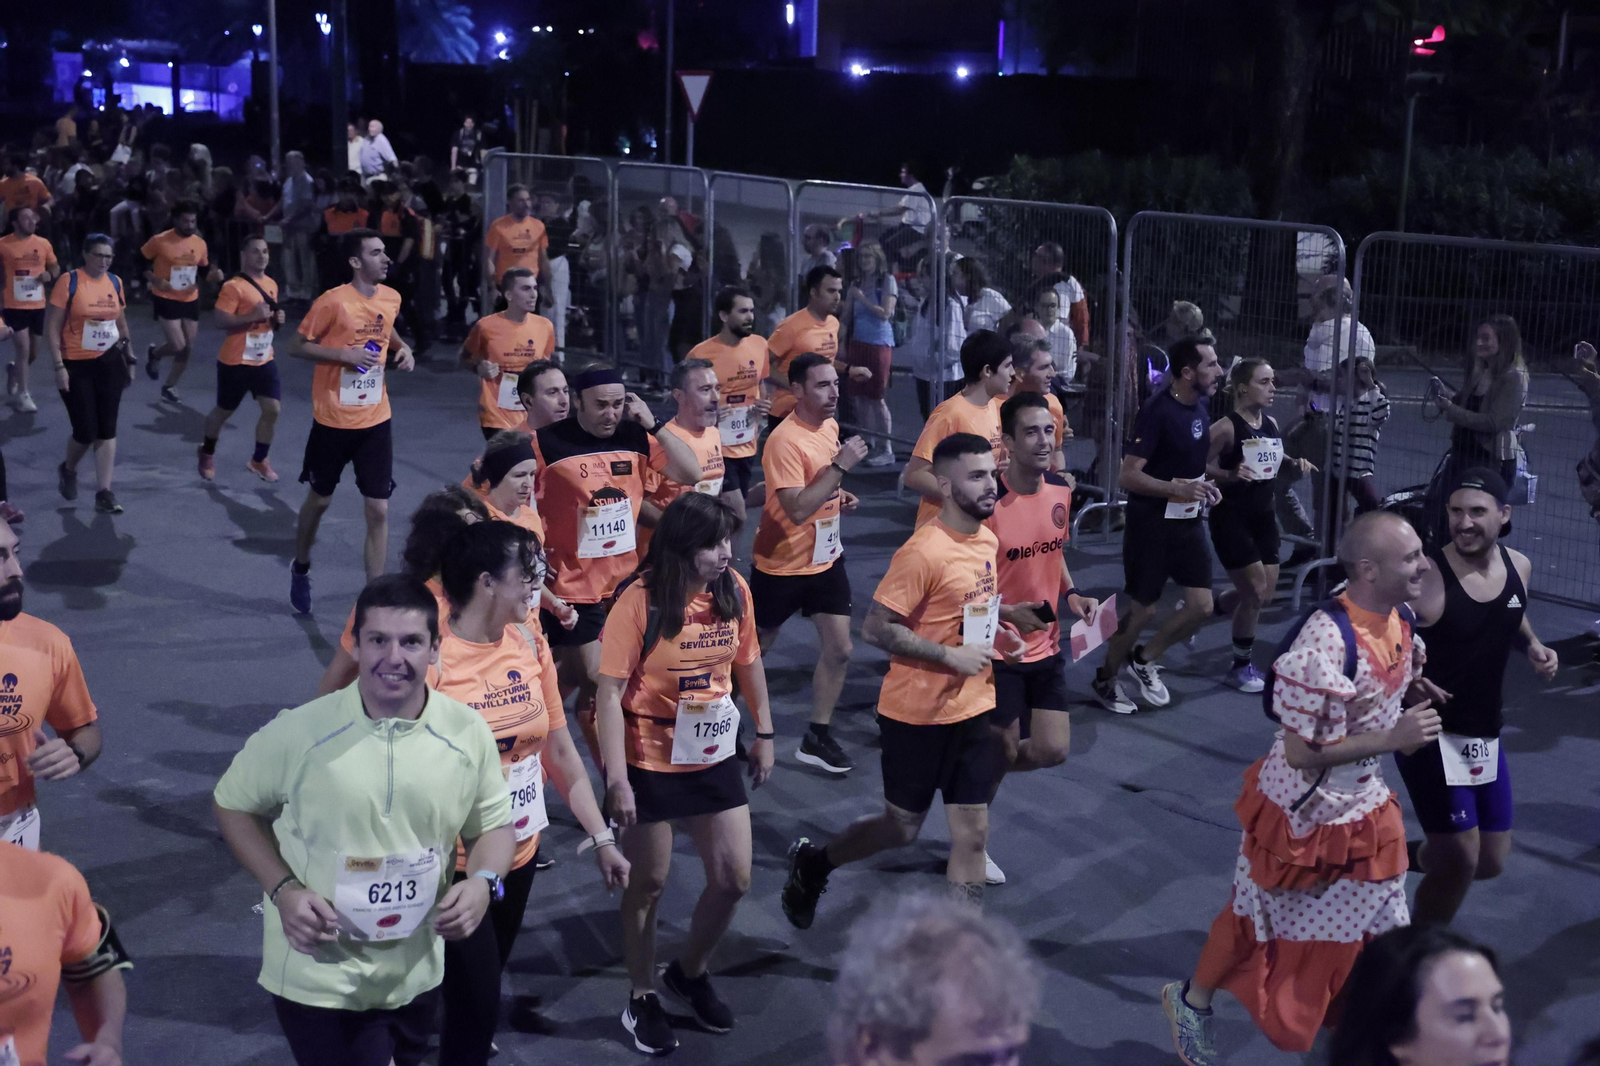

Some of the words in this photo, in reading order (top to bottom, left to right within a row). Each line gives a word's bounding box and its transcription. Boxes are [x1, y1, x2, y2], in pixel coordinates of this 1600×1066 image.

[351, 378, 376, 390] 12158
[1257, 451, 1278, 463] 2518
[591, 519, 627, 537] 11140
[679, 640, 717, 650] SEVILLA
[717, 636, 734, 646] KH7
[698, 628, 735, 640] NOCTURNA
[483, 682, 531, 700] NOCTURNA
[466, 698, 510, 711] SEVILLA
[510, 690, 531, 704] KH7
[693, 717, 732, 738] 17966
[1461, 741, 1490, 759] 4518
[367, 880, 416, 904] 6213
